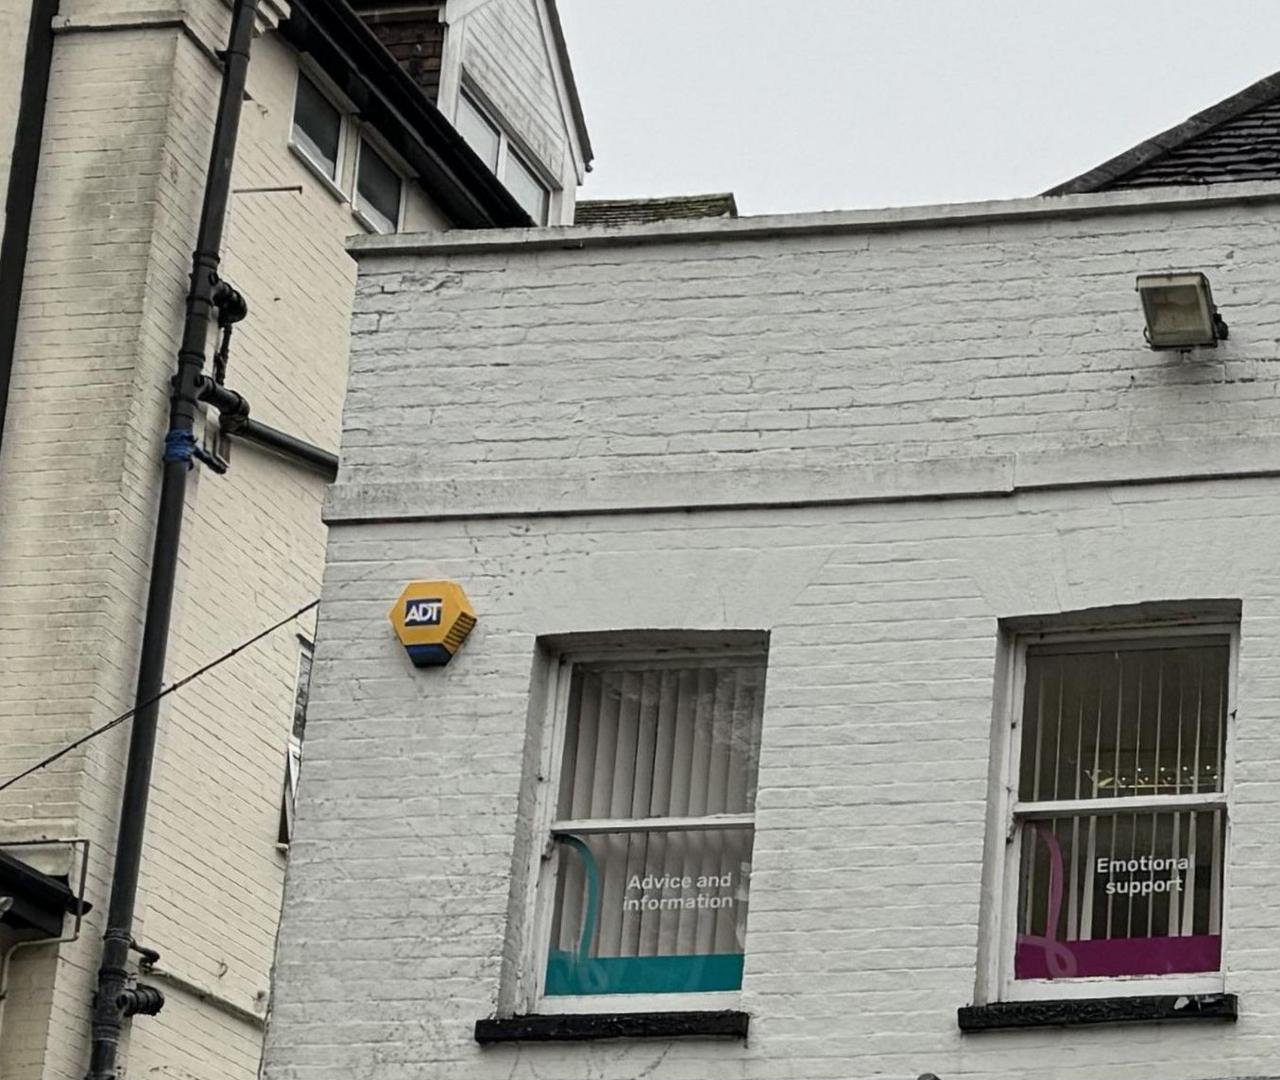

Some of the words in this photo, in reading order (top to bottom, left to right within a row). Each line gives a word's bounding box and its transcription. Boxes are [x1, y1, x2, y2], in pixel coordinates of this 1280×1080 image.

[404, 602, 443, 622] ADT
[1097, 854, 1194, 873] Emotional
[627, 873, 692, 890] Advice
[696, 872, 732, 888] and
[1105, 876, 1183, 896] support
[623, 893, 733, 911] information
